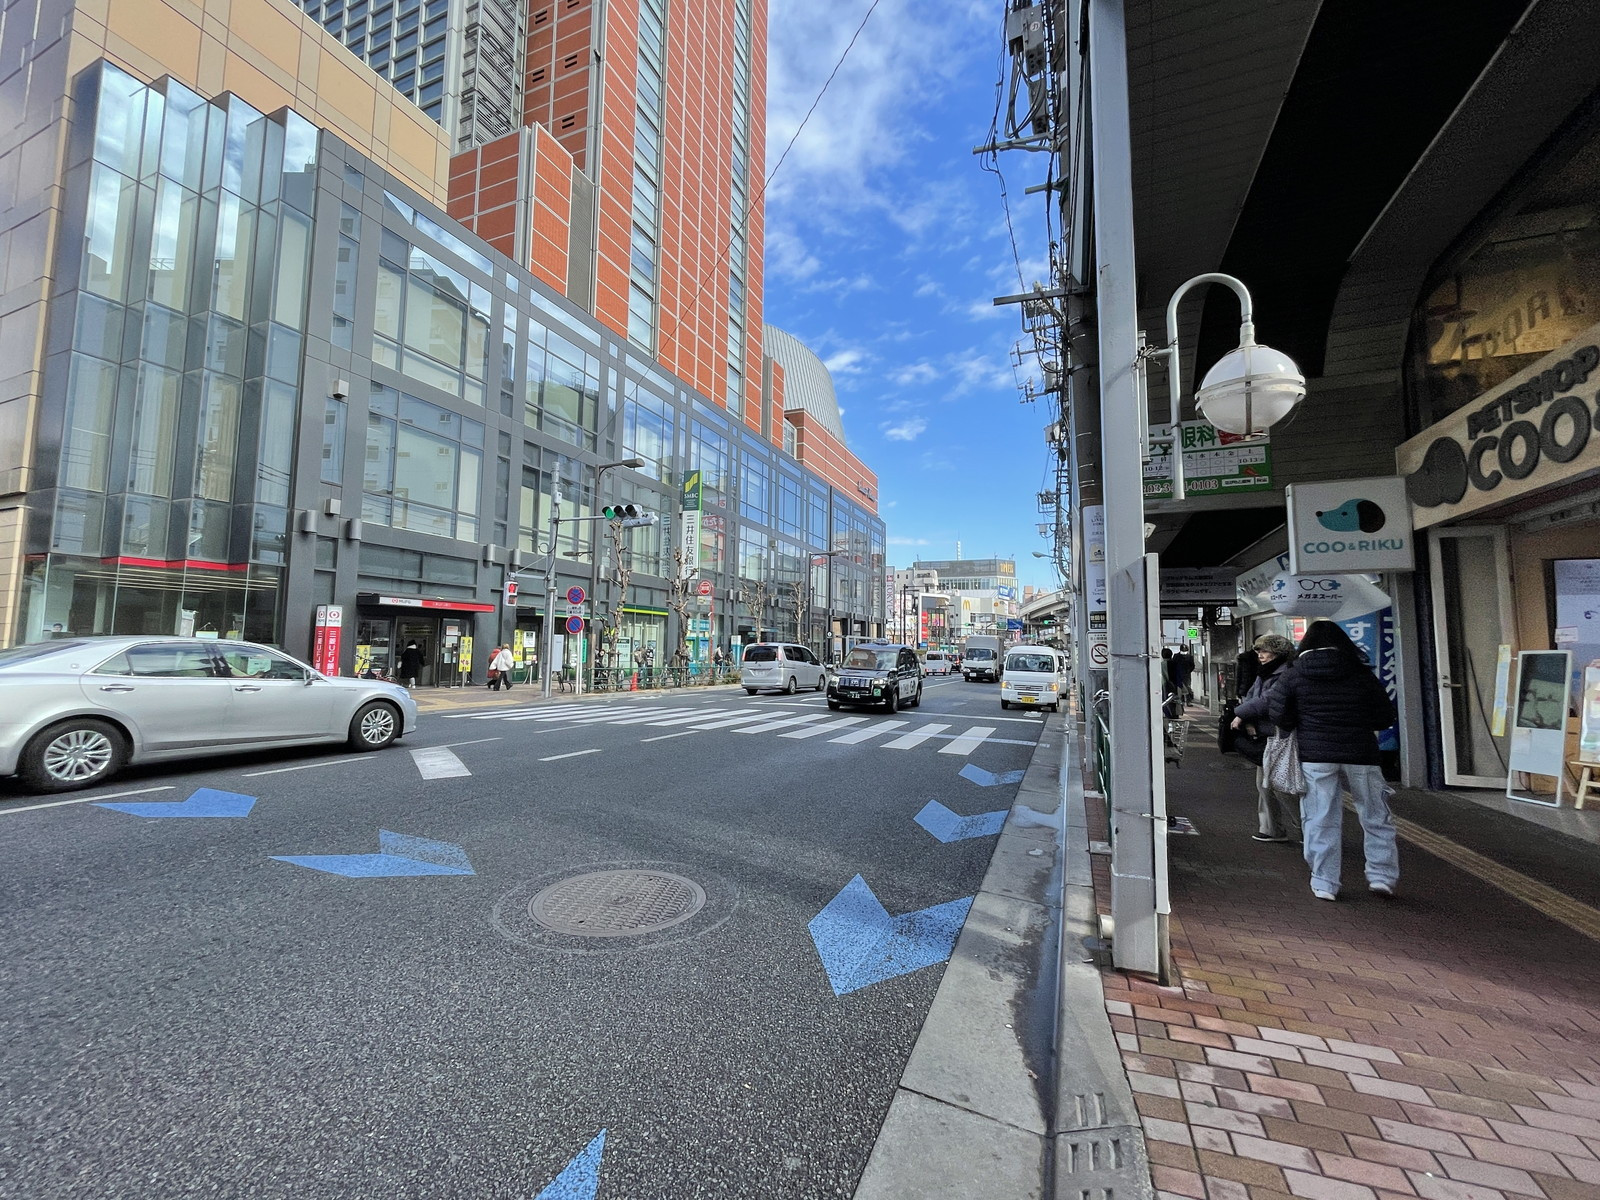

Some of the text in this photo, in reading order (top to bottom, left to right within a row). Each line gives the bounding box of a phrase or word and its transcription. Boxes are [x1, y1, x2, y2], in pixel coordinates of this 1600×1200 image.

[685, 514, 695, 577] 三井住友銀行
[1303, 539, 1404, 554] COO&RIKU
